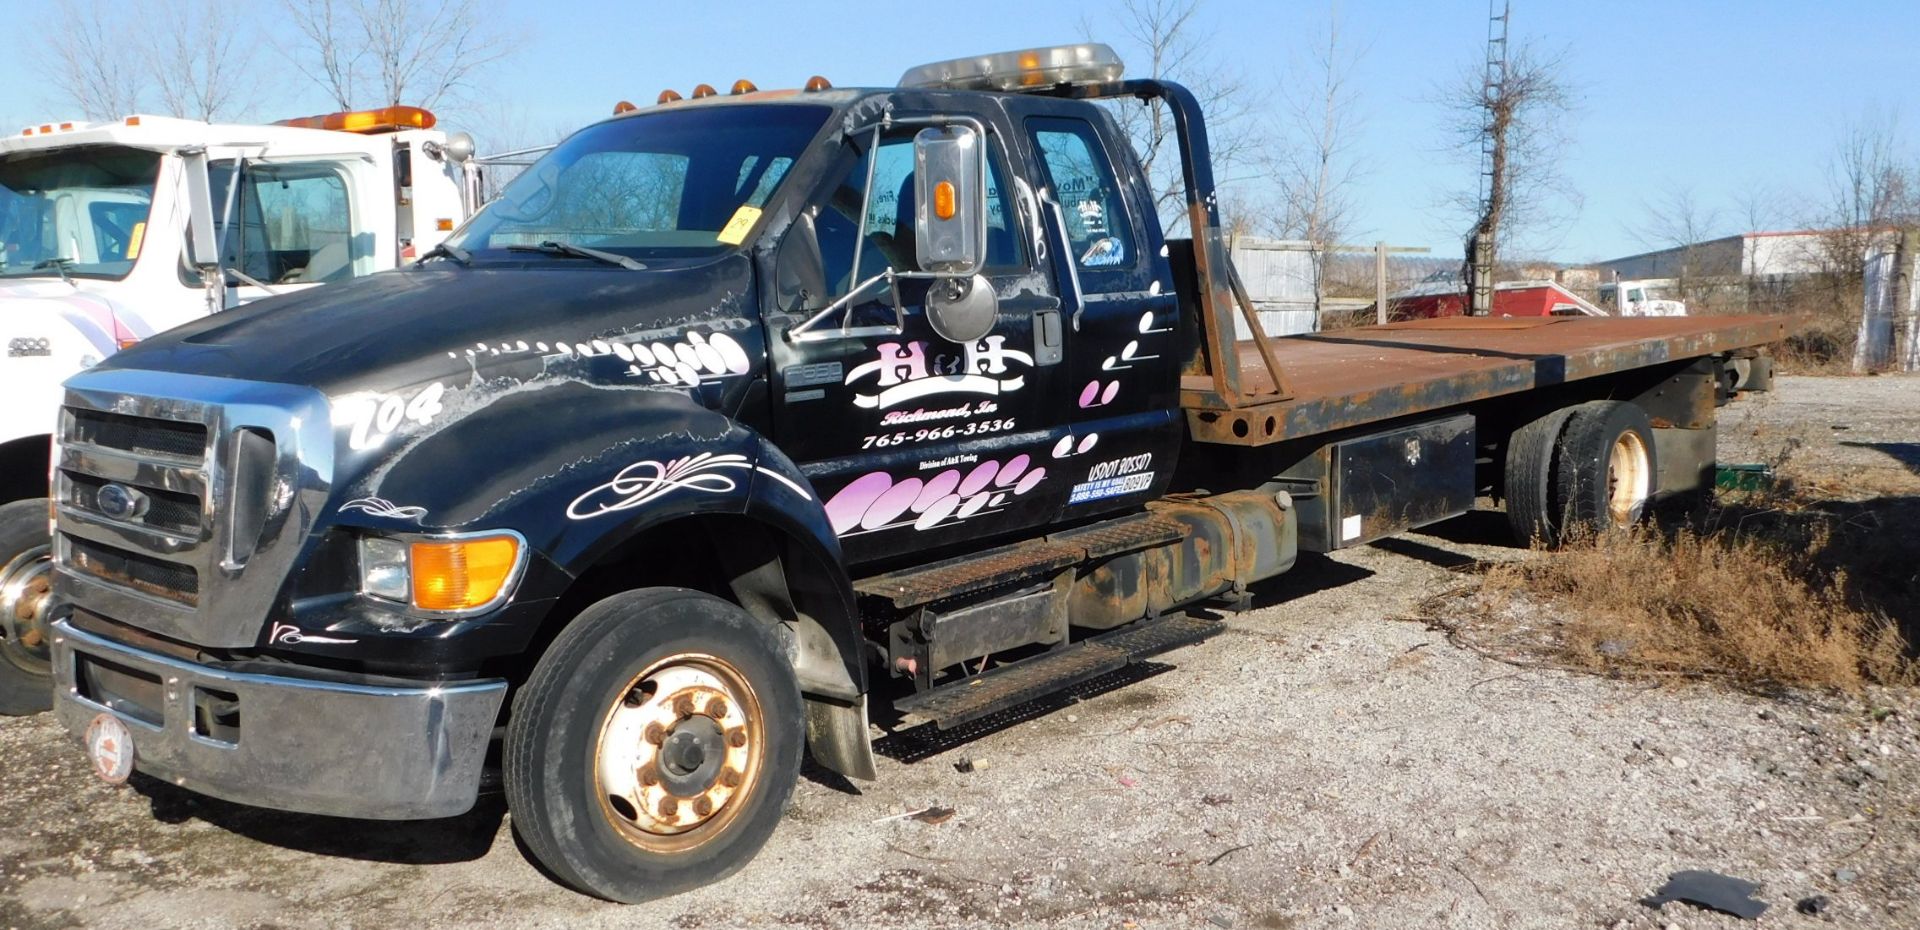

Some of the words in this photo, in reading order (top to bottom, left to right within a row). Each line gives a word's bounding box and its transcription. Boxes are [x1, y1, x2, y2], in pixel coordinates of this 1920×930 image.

[330, 381, 444, 450] 704
[880, 403, 971, 425] Richmond,
[974, 400, 998, 414] In
[861, 417, 1016, 449] 765-966-3536
[919, 460, 940, 470] Division
[960, 453, 978, 463] Towing
[1088, 459, 1120, 481] USDOT
[1073, 482, 1094, 493] SAFETY
